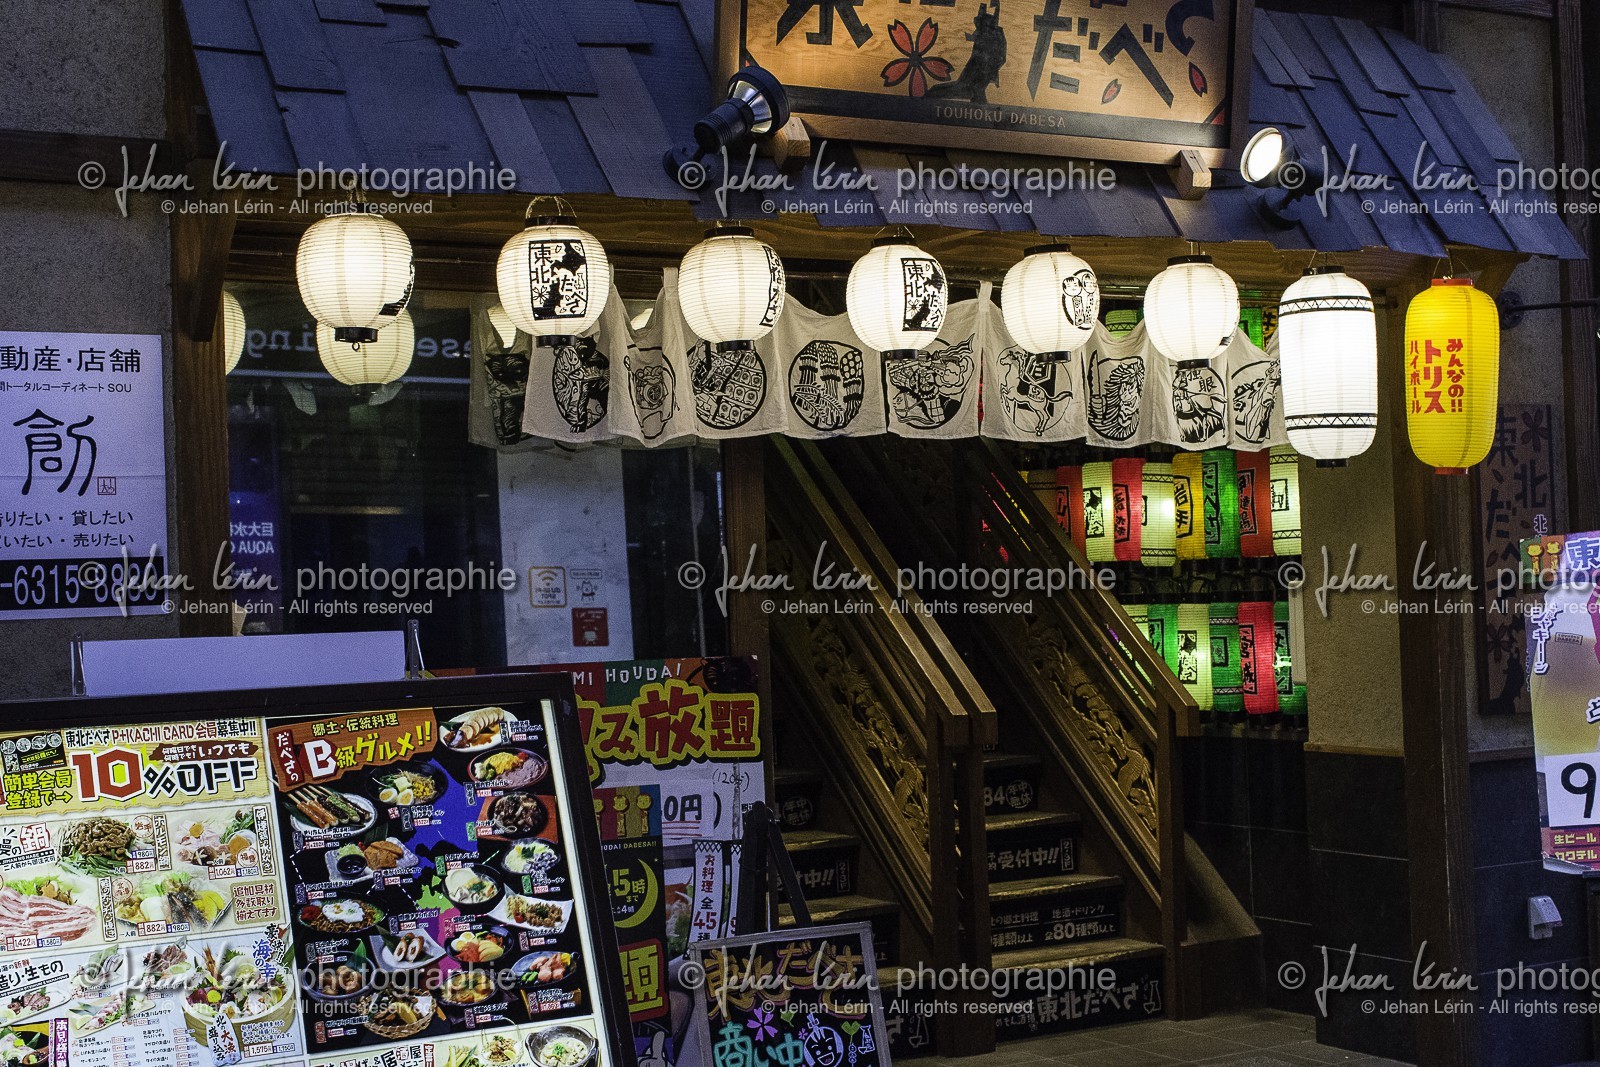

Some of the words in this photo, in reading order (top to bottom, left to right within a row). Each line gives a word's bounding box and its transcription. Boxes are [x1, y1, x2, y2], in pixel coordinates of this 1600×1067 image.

[935, 105, 1002, 123] TOUHOKU
[1010, 112, 1066, 128] DABESA
[531, 243, 552, 284] 東北
[0, 346, 141, 373] 動産・店舗
[1410, 341, 1421, 414] ハイボール
[1424, 340, 1445, 413] トリス
[1446, 339, 1465, 412] みんなの!!
[107, 384, 132, 393] SOU
[0, 533, 134, 548] いたい・売りたい
[605, 663, 681, 684] HOUDAI
[163, 725, 194, 740] CARD
[198, 743, 250, 757] いつでも
[276, 732, 299, 782] だべさの
[4, 769, 72, 791] 簡単会員
[1554, 832, 1597, 845] 生ビール
[991, 931, 1033, 947] 種類以上
[252, 939, 277, 981] 海の幸
